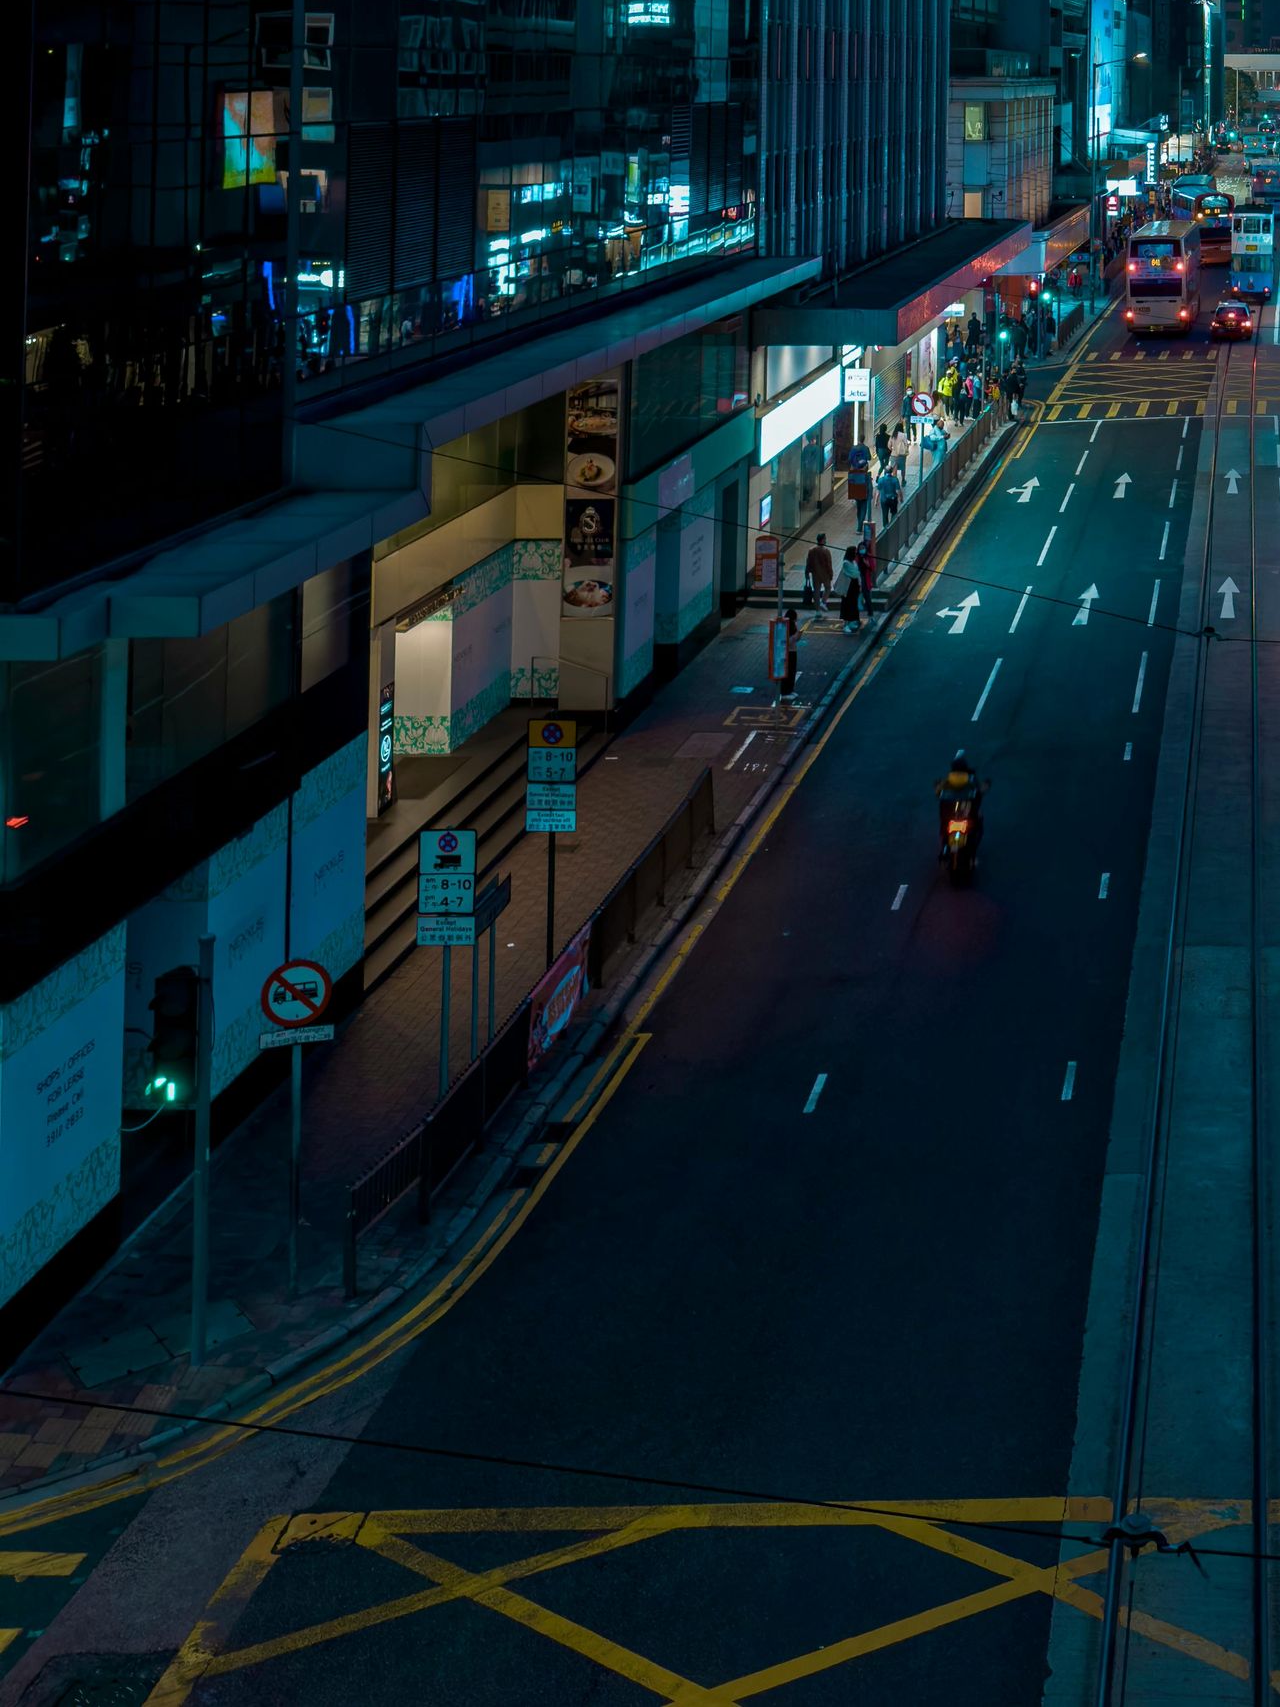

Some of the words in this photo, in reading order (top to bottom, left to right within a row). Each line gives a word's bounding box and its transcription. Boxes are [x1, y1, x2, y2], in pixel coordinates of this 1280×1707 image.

[545, 751, 573, 762] 8-10
[440, 879, 472, 890] 8-10
[440, 896, 464, 907] 4-7
